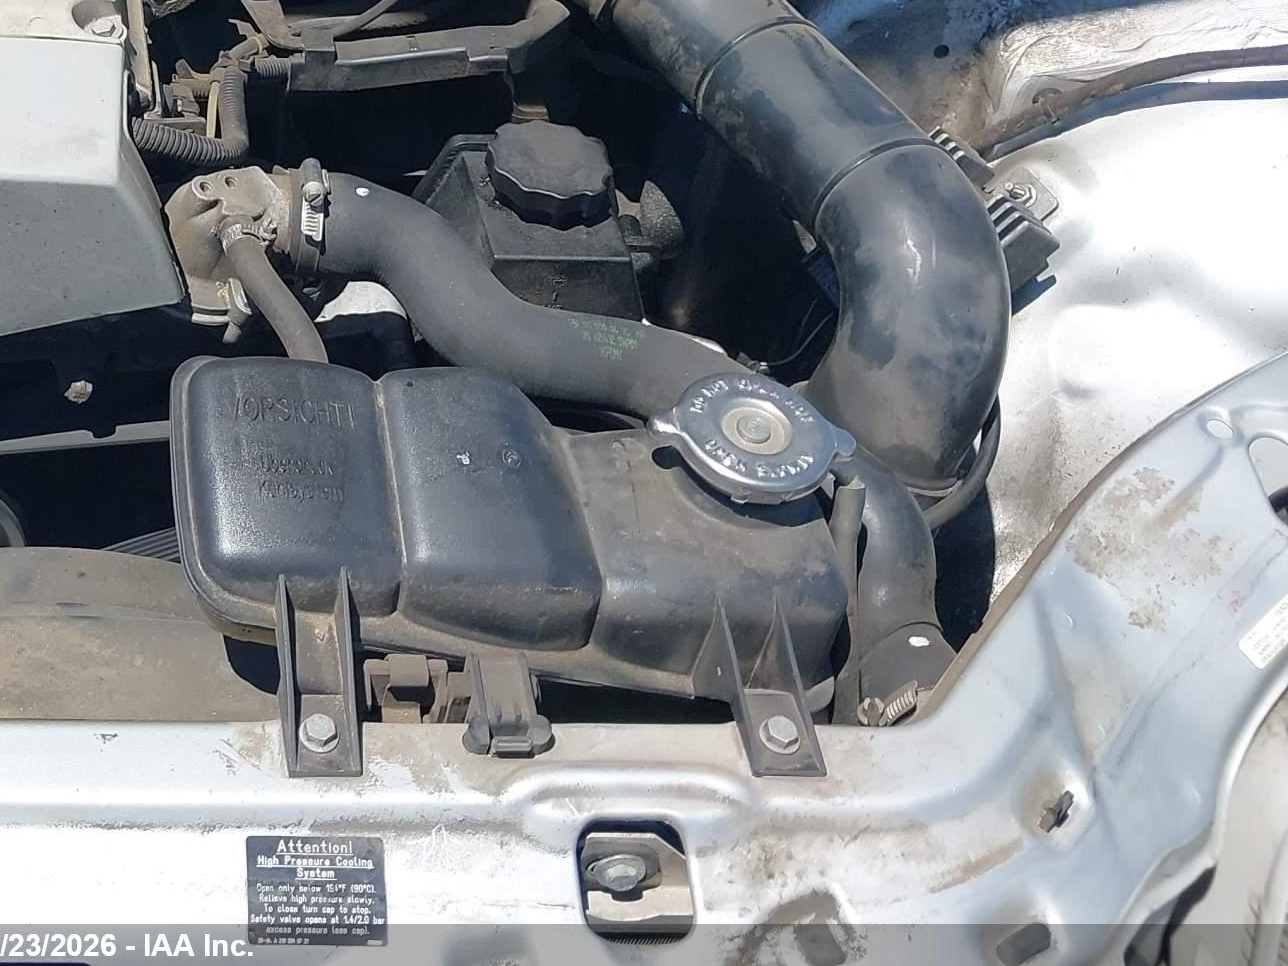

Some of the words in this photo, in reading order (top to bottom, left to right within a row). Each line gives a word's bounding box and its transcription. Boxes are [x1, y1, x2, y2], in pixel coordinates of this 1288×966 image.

[277, 839, 353, 853] Attention!
[257, 855, 279, 867] High
[284, 855, 331, 866] Pressure
[335, 856, 373, 868] Cooling
[296, 867, 335, 879] System
[256, 883, 274, 894] Open
[278, 884, 295, 895] only
[299, 884, 321, 893] below
[259, 894, 288, 903] Relieve
[291, 894, 307, 905] high
[311, 896, 343, 905] pressure
[347, 895, 375, 905] slowly.
[264, 903, 273, 912] To
[277, 904, 298, 913] close
[302, 904, 318, 913] turn
[322, 906, 335, 915] cap
[339, 905, 348, 914] to
[351, 905, 372, 915] stop.
[250, 913, 275, 924] Safety
[279, 914, 301, 923] valve
[305, 916, 327, 925] opens
[331, 915, 339, 924] at
[343, 915, 370, 924] 1.4/2.0
[373, 915, 385, 924] bar
[266, 926, 292, 934] excess
[296, 926, 328, 935] pressure
[332, 926, 348, 935] (see
[352, 926, 370, 936] cap).
